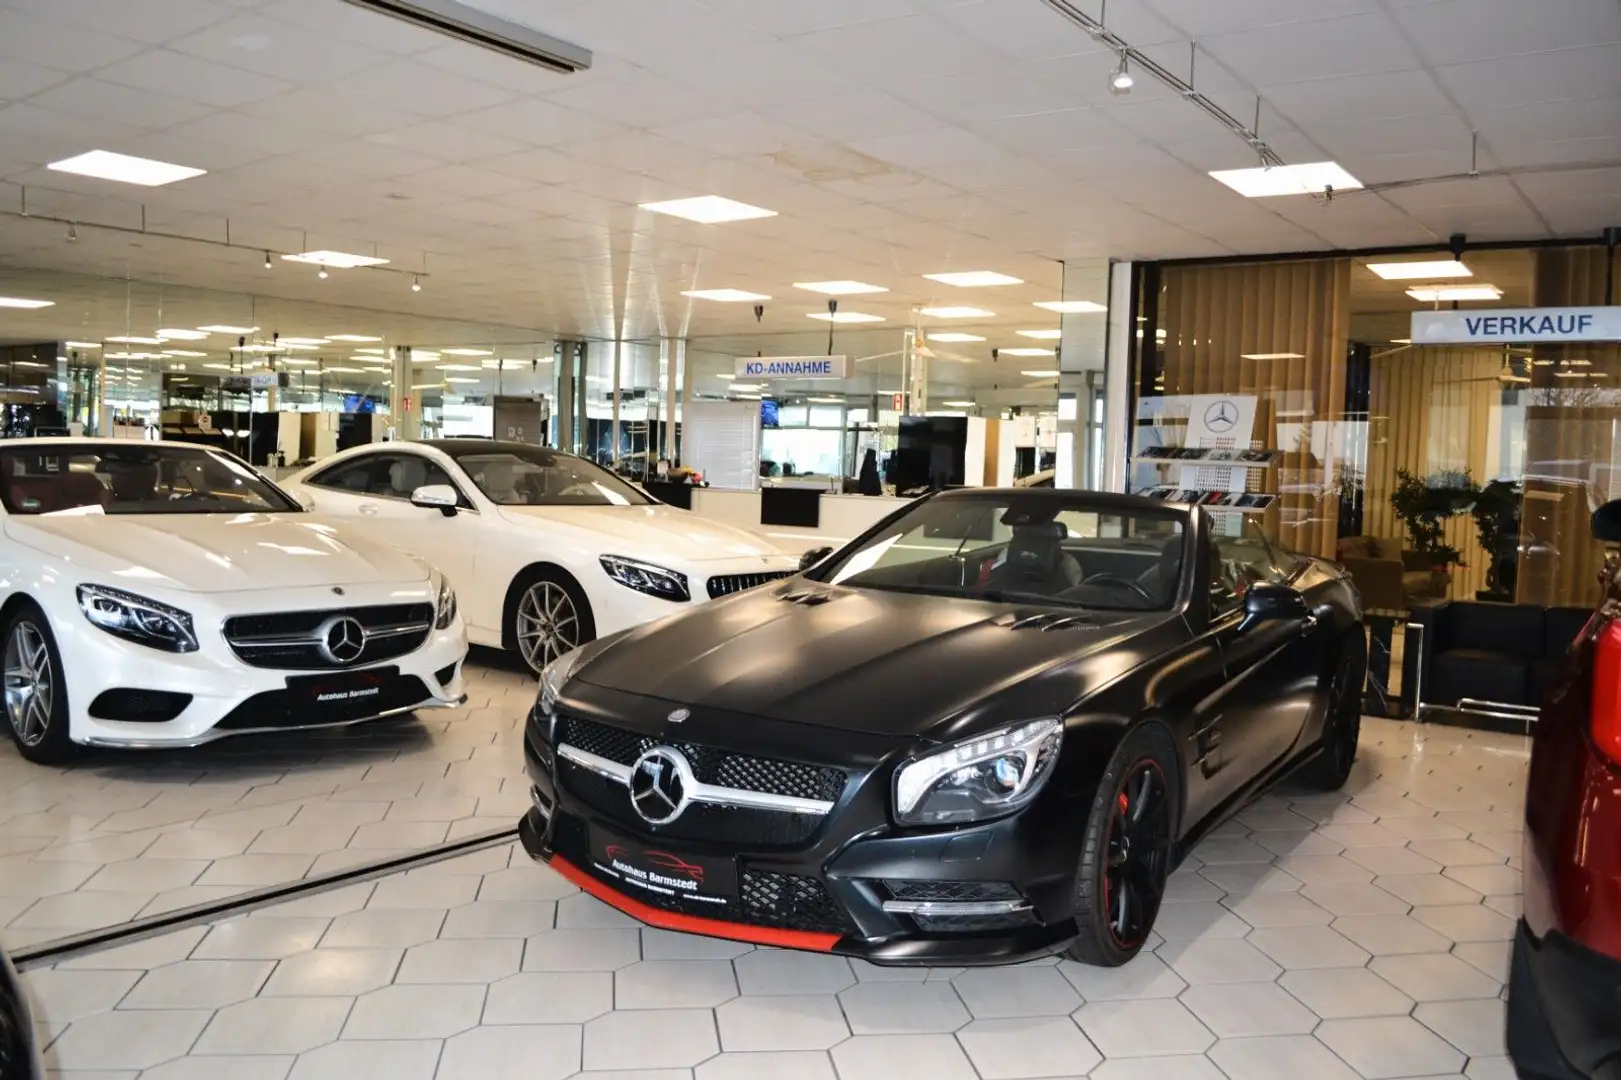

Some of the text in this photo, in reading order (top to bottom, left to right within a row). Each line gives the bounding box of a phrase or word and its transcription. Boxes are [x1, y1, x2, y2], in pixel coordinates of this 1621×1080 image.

[1465, 314, 1594, 336] VERKAUF
[746, 360, 832, 375] KD-ANNAHME
[317, 691, 348, 702] Autohaus
[611, 858, 648, 880] Autohaus
[648, 871, 698, 891] Barmstedt
